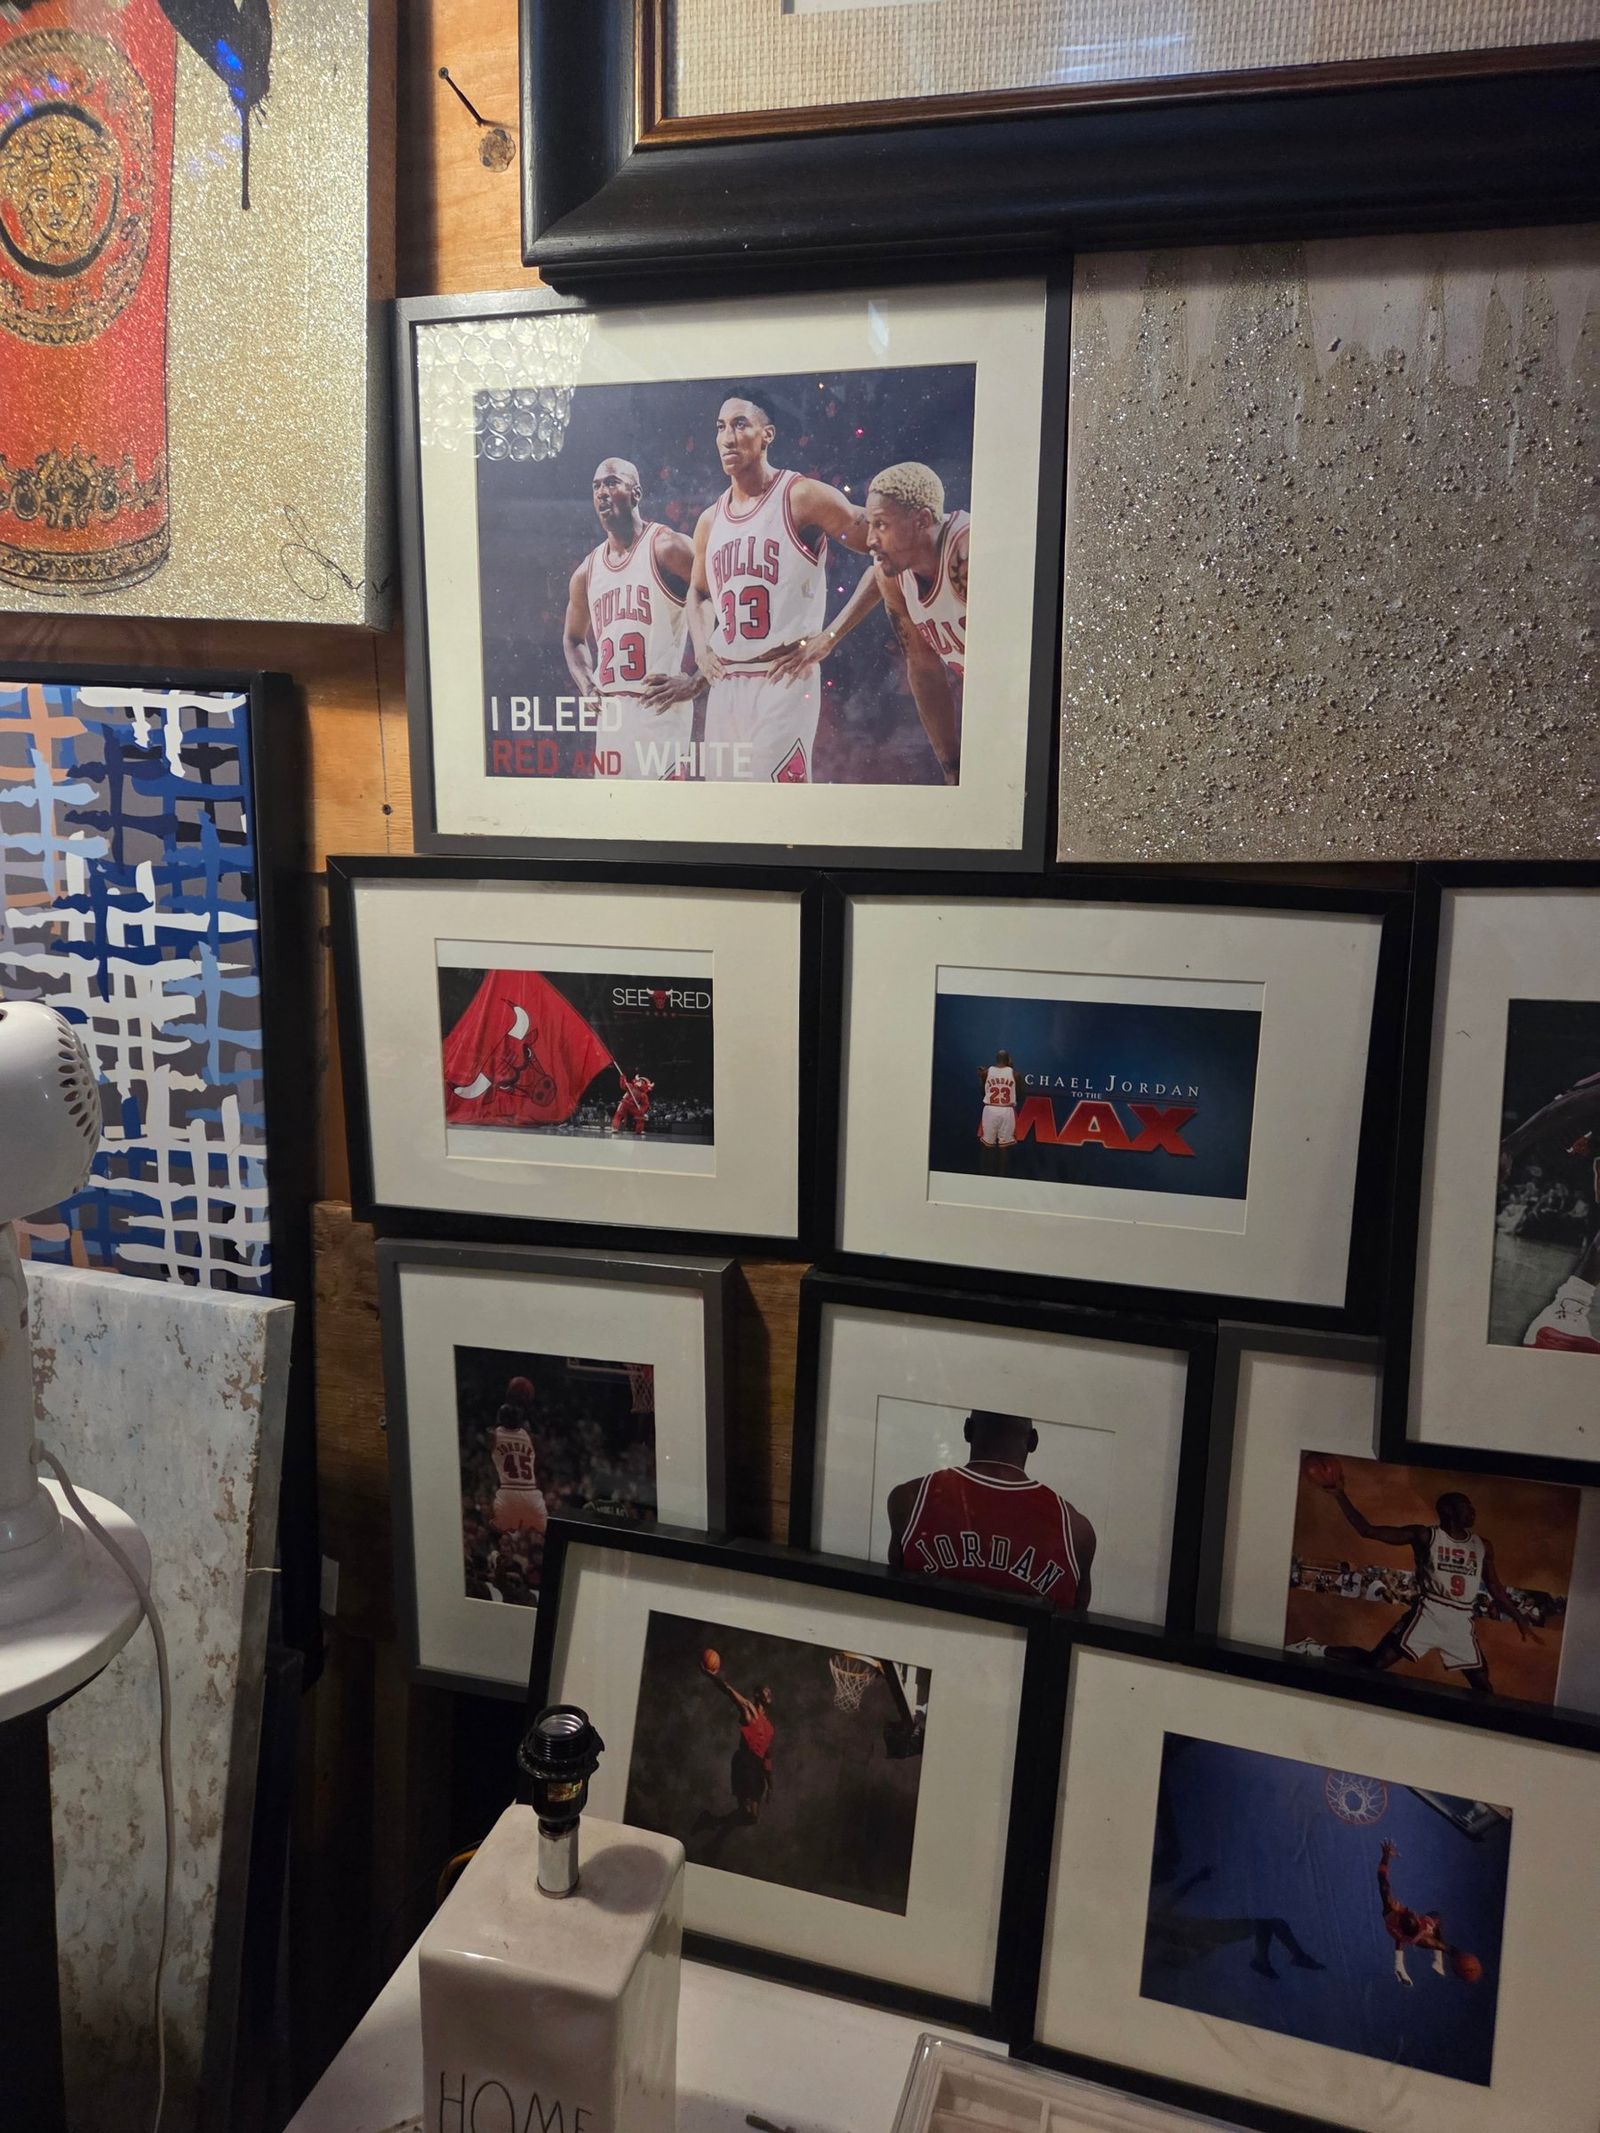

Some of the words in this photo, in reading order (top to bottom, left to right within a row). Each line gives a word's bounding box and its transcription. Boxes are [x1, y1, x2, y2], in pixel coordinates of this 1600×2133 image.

[712, 536, 780, 596] BULLS
[593, 585, 652, 642] BULLS
[721, 585, 771, 645] 33
[599, 632, 647, 687] 23
[491, 696, 499, 731] I
[511, 696, 623, 732] BLEED
[492, 739, 559, 775] RED
[572, 750, 622, 776] AND
[635, 741, 754, 777] WHITE
[612, 987, 650, 1007] SEE
[670, 990, 711, 1009] RED
[990, 1087, 1011, 1104] 23
[1024, 1073, 1094, 1090] CHAEL
[1086, 1092, 1102, 1100] THE
[504, 1454, 533, 1480] 45
[915, 1531, 1064, 1596] JORDAN
[1438, 1546, 1478, 1567] USA
[1451, 1575, 1466, 1597] 9
